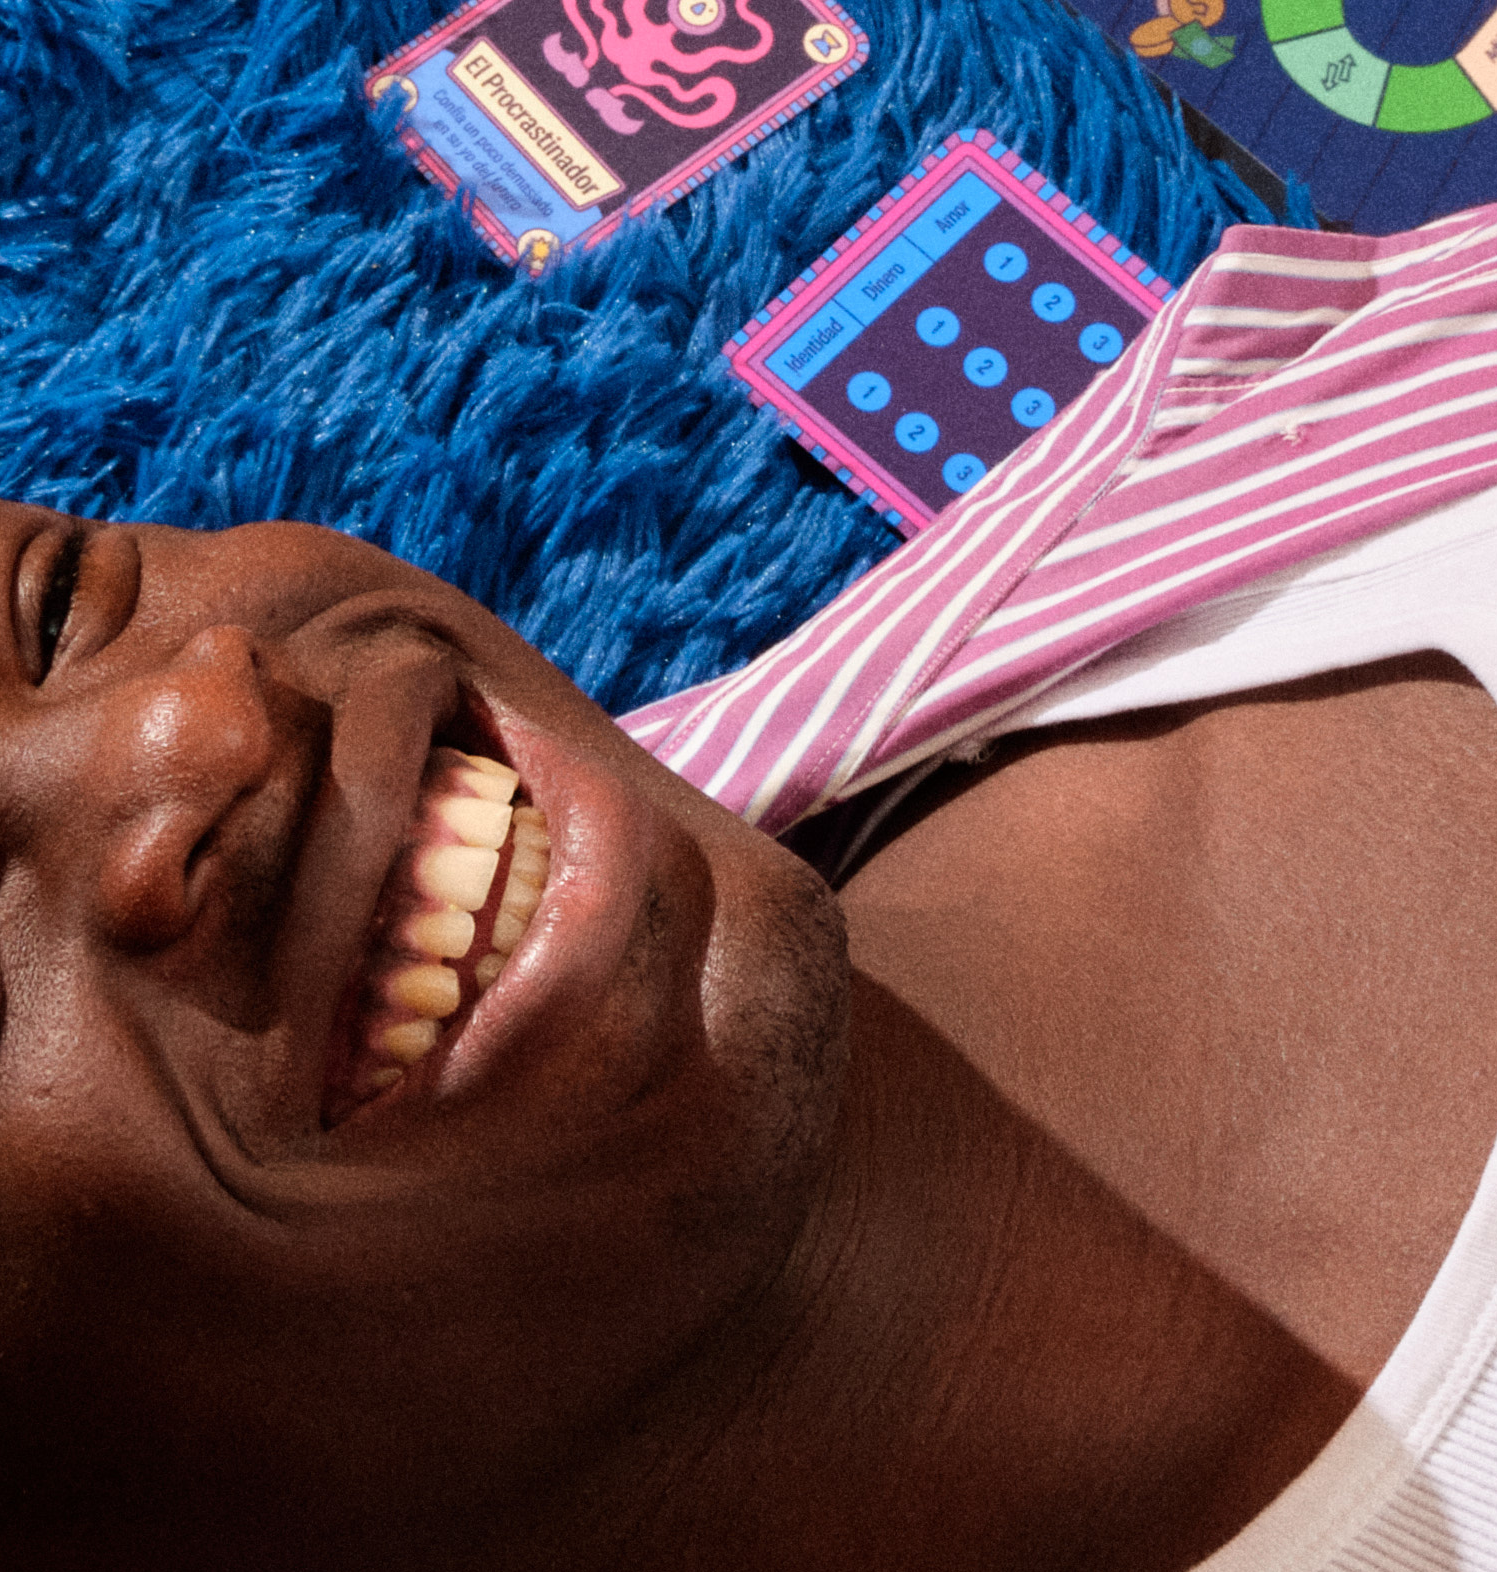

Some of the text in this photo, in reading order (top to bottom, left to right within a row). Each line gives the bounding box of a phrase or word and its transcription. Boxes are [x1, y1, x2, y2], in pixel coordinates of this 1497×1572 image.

[464, 54, 600, 209] El Procrastinador
[432, 88, 554, 219] Confía un poco demasiado
[425, 119, 533, 214] en su yo del futuro
[934, 200, 971, 234] Amor
[999, 256, 1014, 271] 1
[860, 262, 906, 302] Dinero
[1043, 294, 1062, 311] 2
[931, 320, 946, 335] 1
[783, 316, 845, 373] Identidad
[1092, 334, 1111, 351] 3
[975, 358, 995, 376] 2
[862, 385, 877, 400] 1
[1024, 399, 1043, 417] 3
[907, 424, 926, 442] 2
[955, 465, 974, 482] 3
